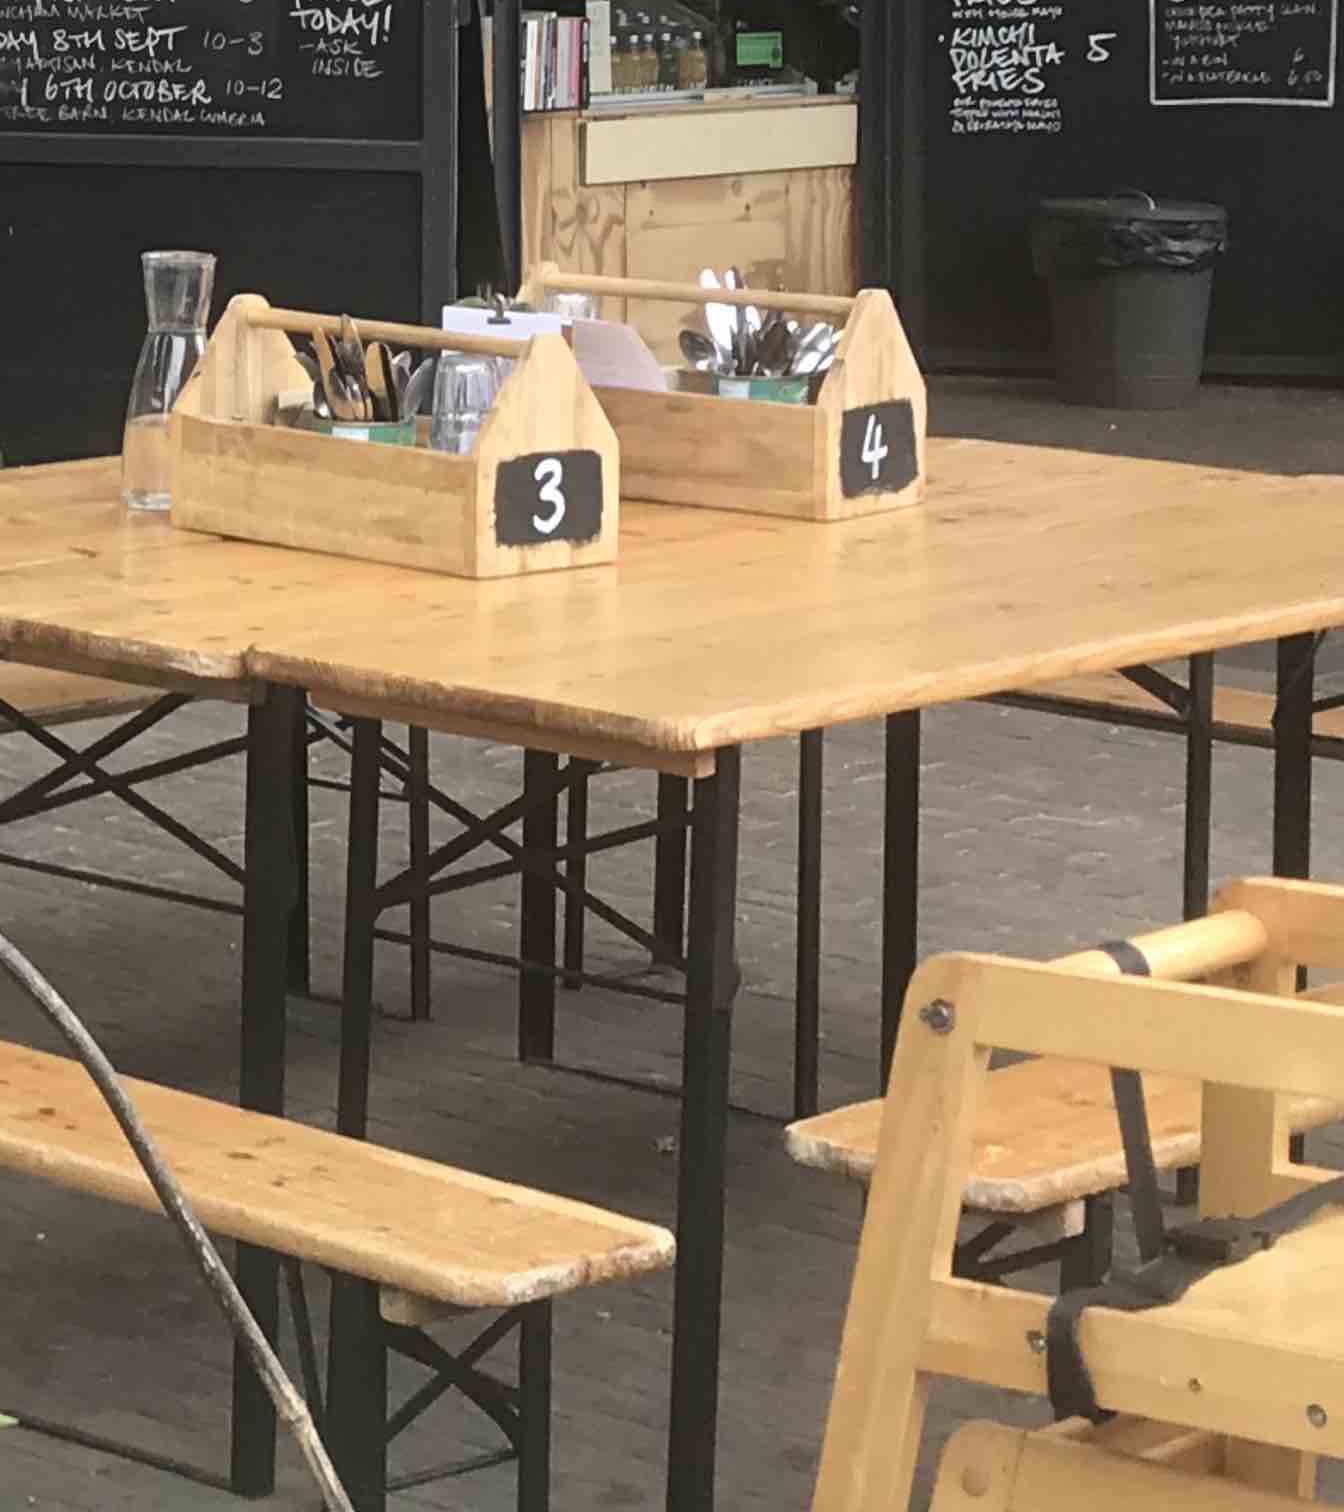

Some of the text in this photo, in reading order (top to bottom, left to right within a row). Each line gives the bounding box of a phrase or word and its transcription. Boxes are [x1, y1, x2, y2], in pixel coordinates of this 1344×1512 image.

[289, 4, 393, 47] TODAY!
[951, 23, 1036, 47] KIMCHI
[53, 29, 106, 52] 8TH
[114, 25, 189, 56] SEPT
[203, 31, 263, 55] 10-3
[1085, 32, 1118, 63] 5
[112, 57, 192, 73] KENDAL
[310, 56, 383, 78] INSIDE
[950, 42, 1065, 69] POLENTA
[44, 77, 95, 102] 6TH
[103, 80, 213, 105] OCTOBER
[225, 78, 284, 99] 10-12
[951, 67, 1047, 94] FRIES
[121, 106, 196, 125] KENDAL
[861, 414, 888, 480] 4
[532, 457, 566, 534] 3
